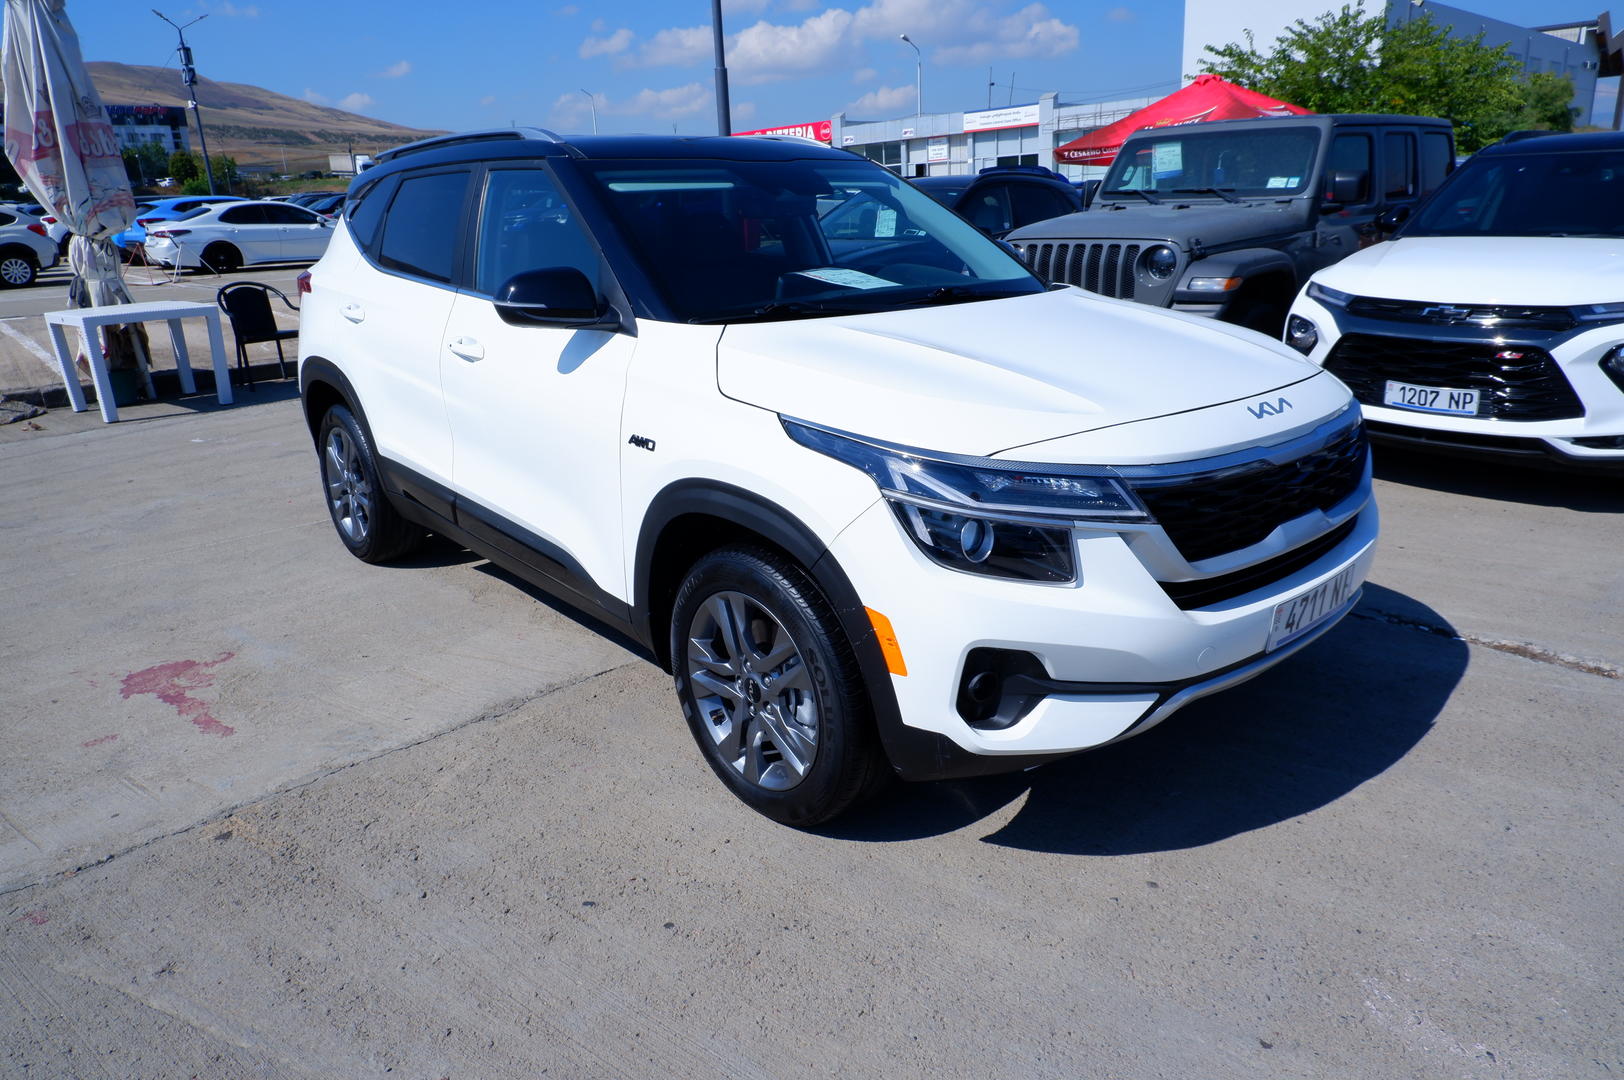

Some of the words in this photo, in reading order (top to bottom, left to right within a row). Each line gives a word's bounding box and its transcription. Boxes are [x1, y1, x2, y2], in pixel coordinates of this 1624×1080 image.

[1399, 386, 1440, 408] 1207
[1448, 391, 1474, 410] NP
[628, 434, 656, 452] AWD
[1285, 584, 1328, 633] 4711
